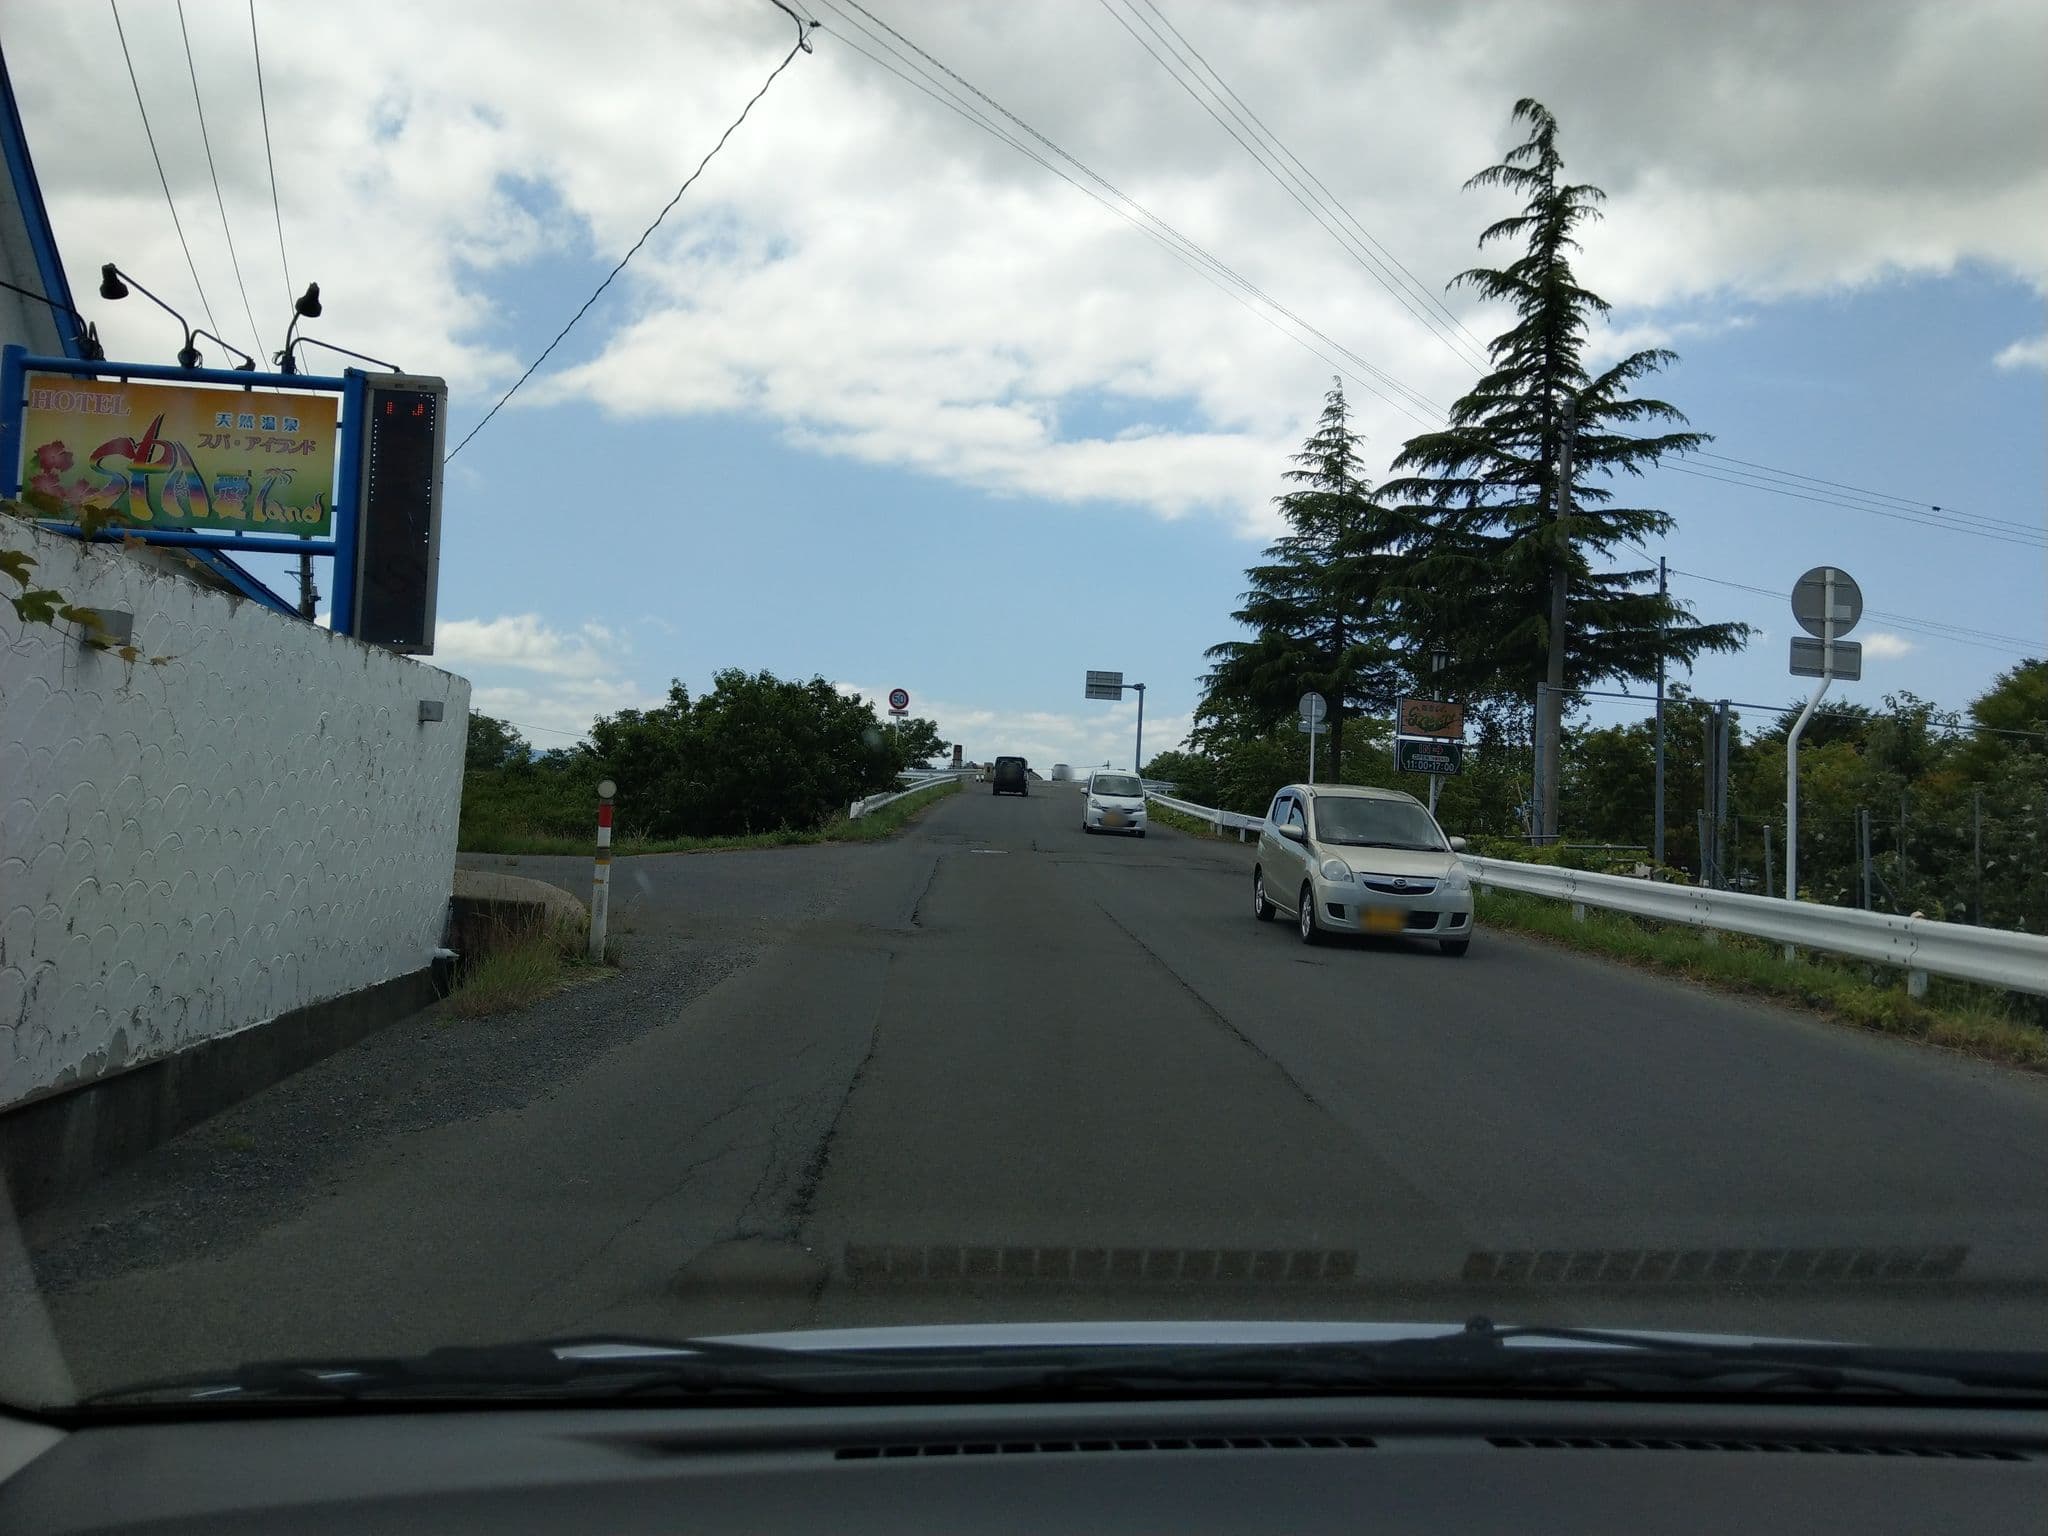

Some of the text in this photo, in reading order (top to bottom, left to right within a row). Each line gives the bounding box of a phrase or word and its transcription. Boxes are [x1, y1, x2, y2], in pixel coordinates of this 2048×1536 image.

[31, 388, 131, 416] HOTEL
[215, 412, 301, 433] 天然温泉
[197, 432, 317, 456] スパ・アイランド
[893, 694, 905, 704] 50
